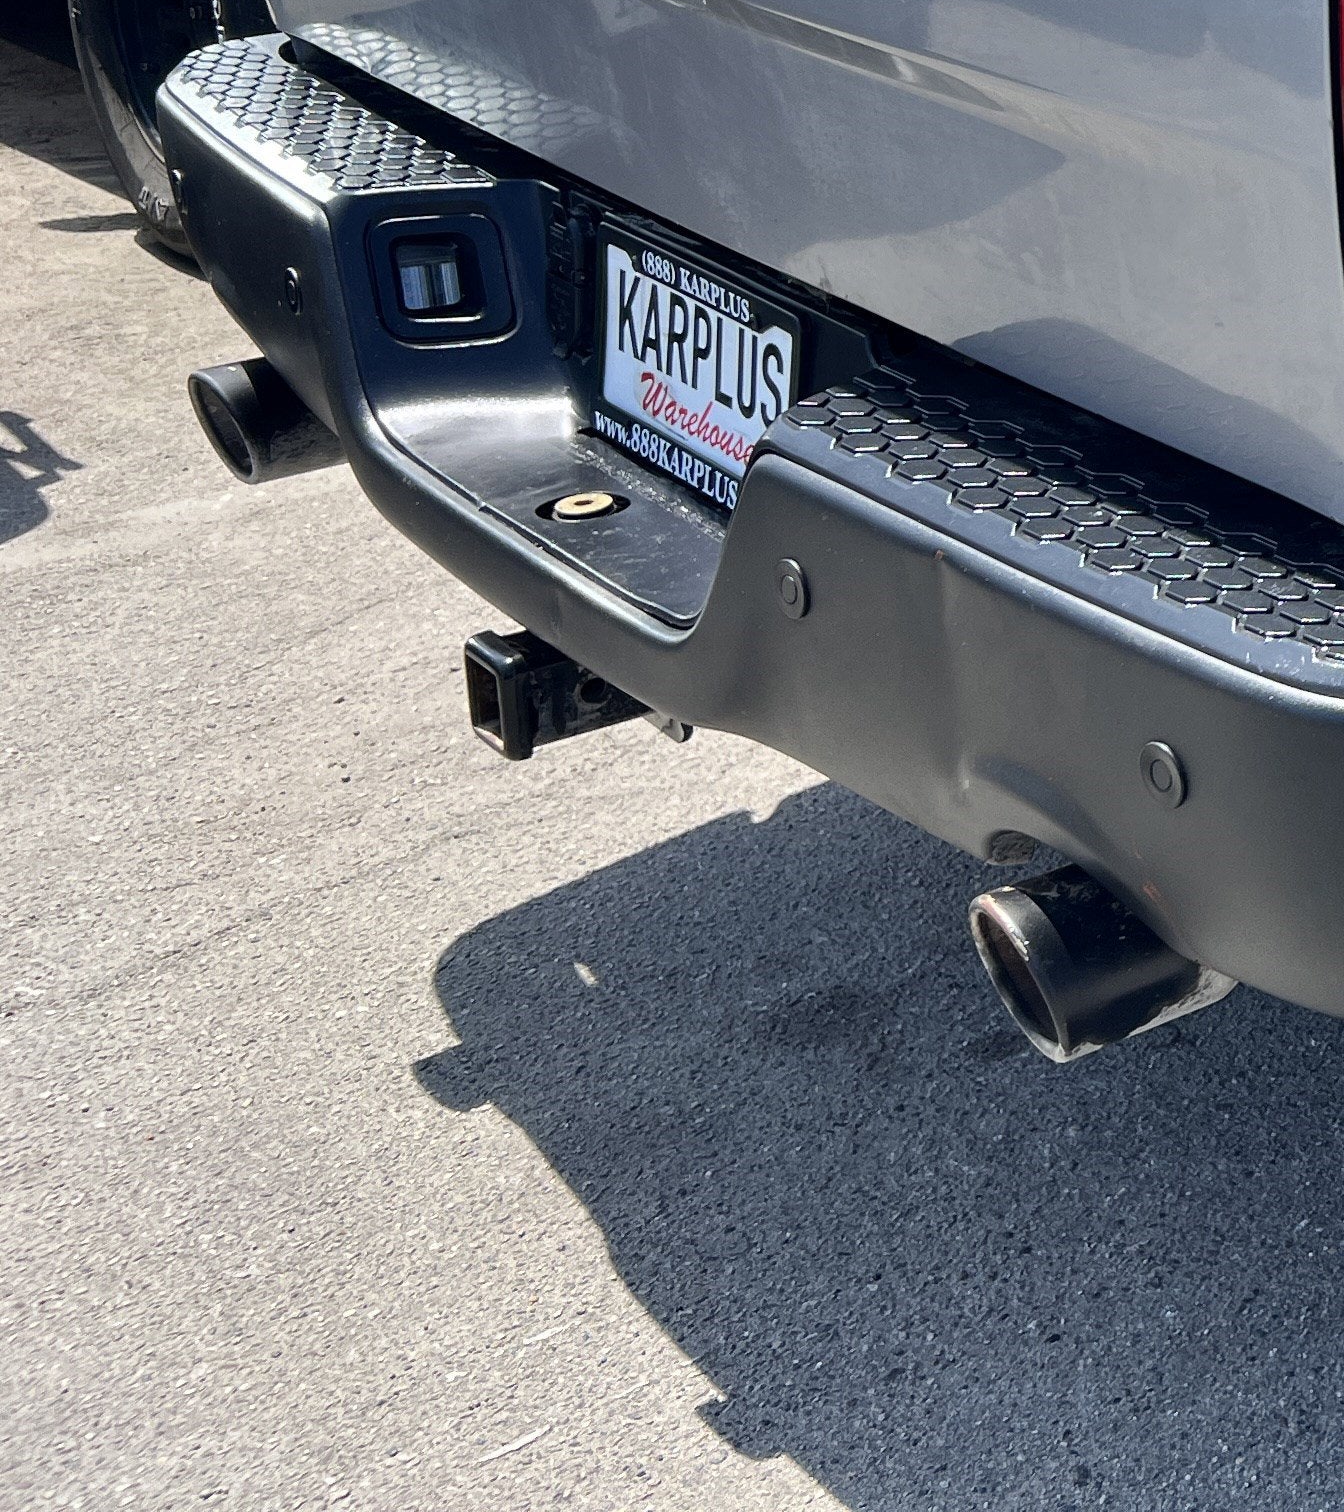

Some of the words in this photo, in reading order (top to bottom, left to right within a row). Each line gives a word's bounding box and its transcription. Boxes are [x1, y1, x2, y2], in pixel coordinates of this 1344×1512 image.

[641, 249, 676, 286] (888)
[679, 266, 750, 323] KARPLUS
[618, 268, 784, 429] KARPLUS
